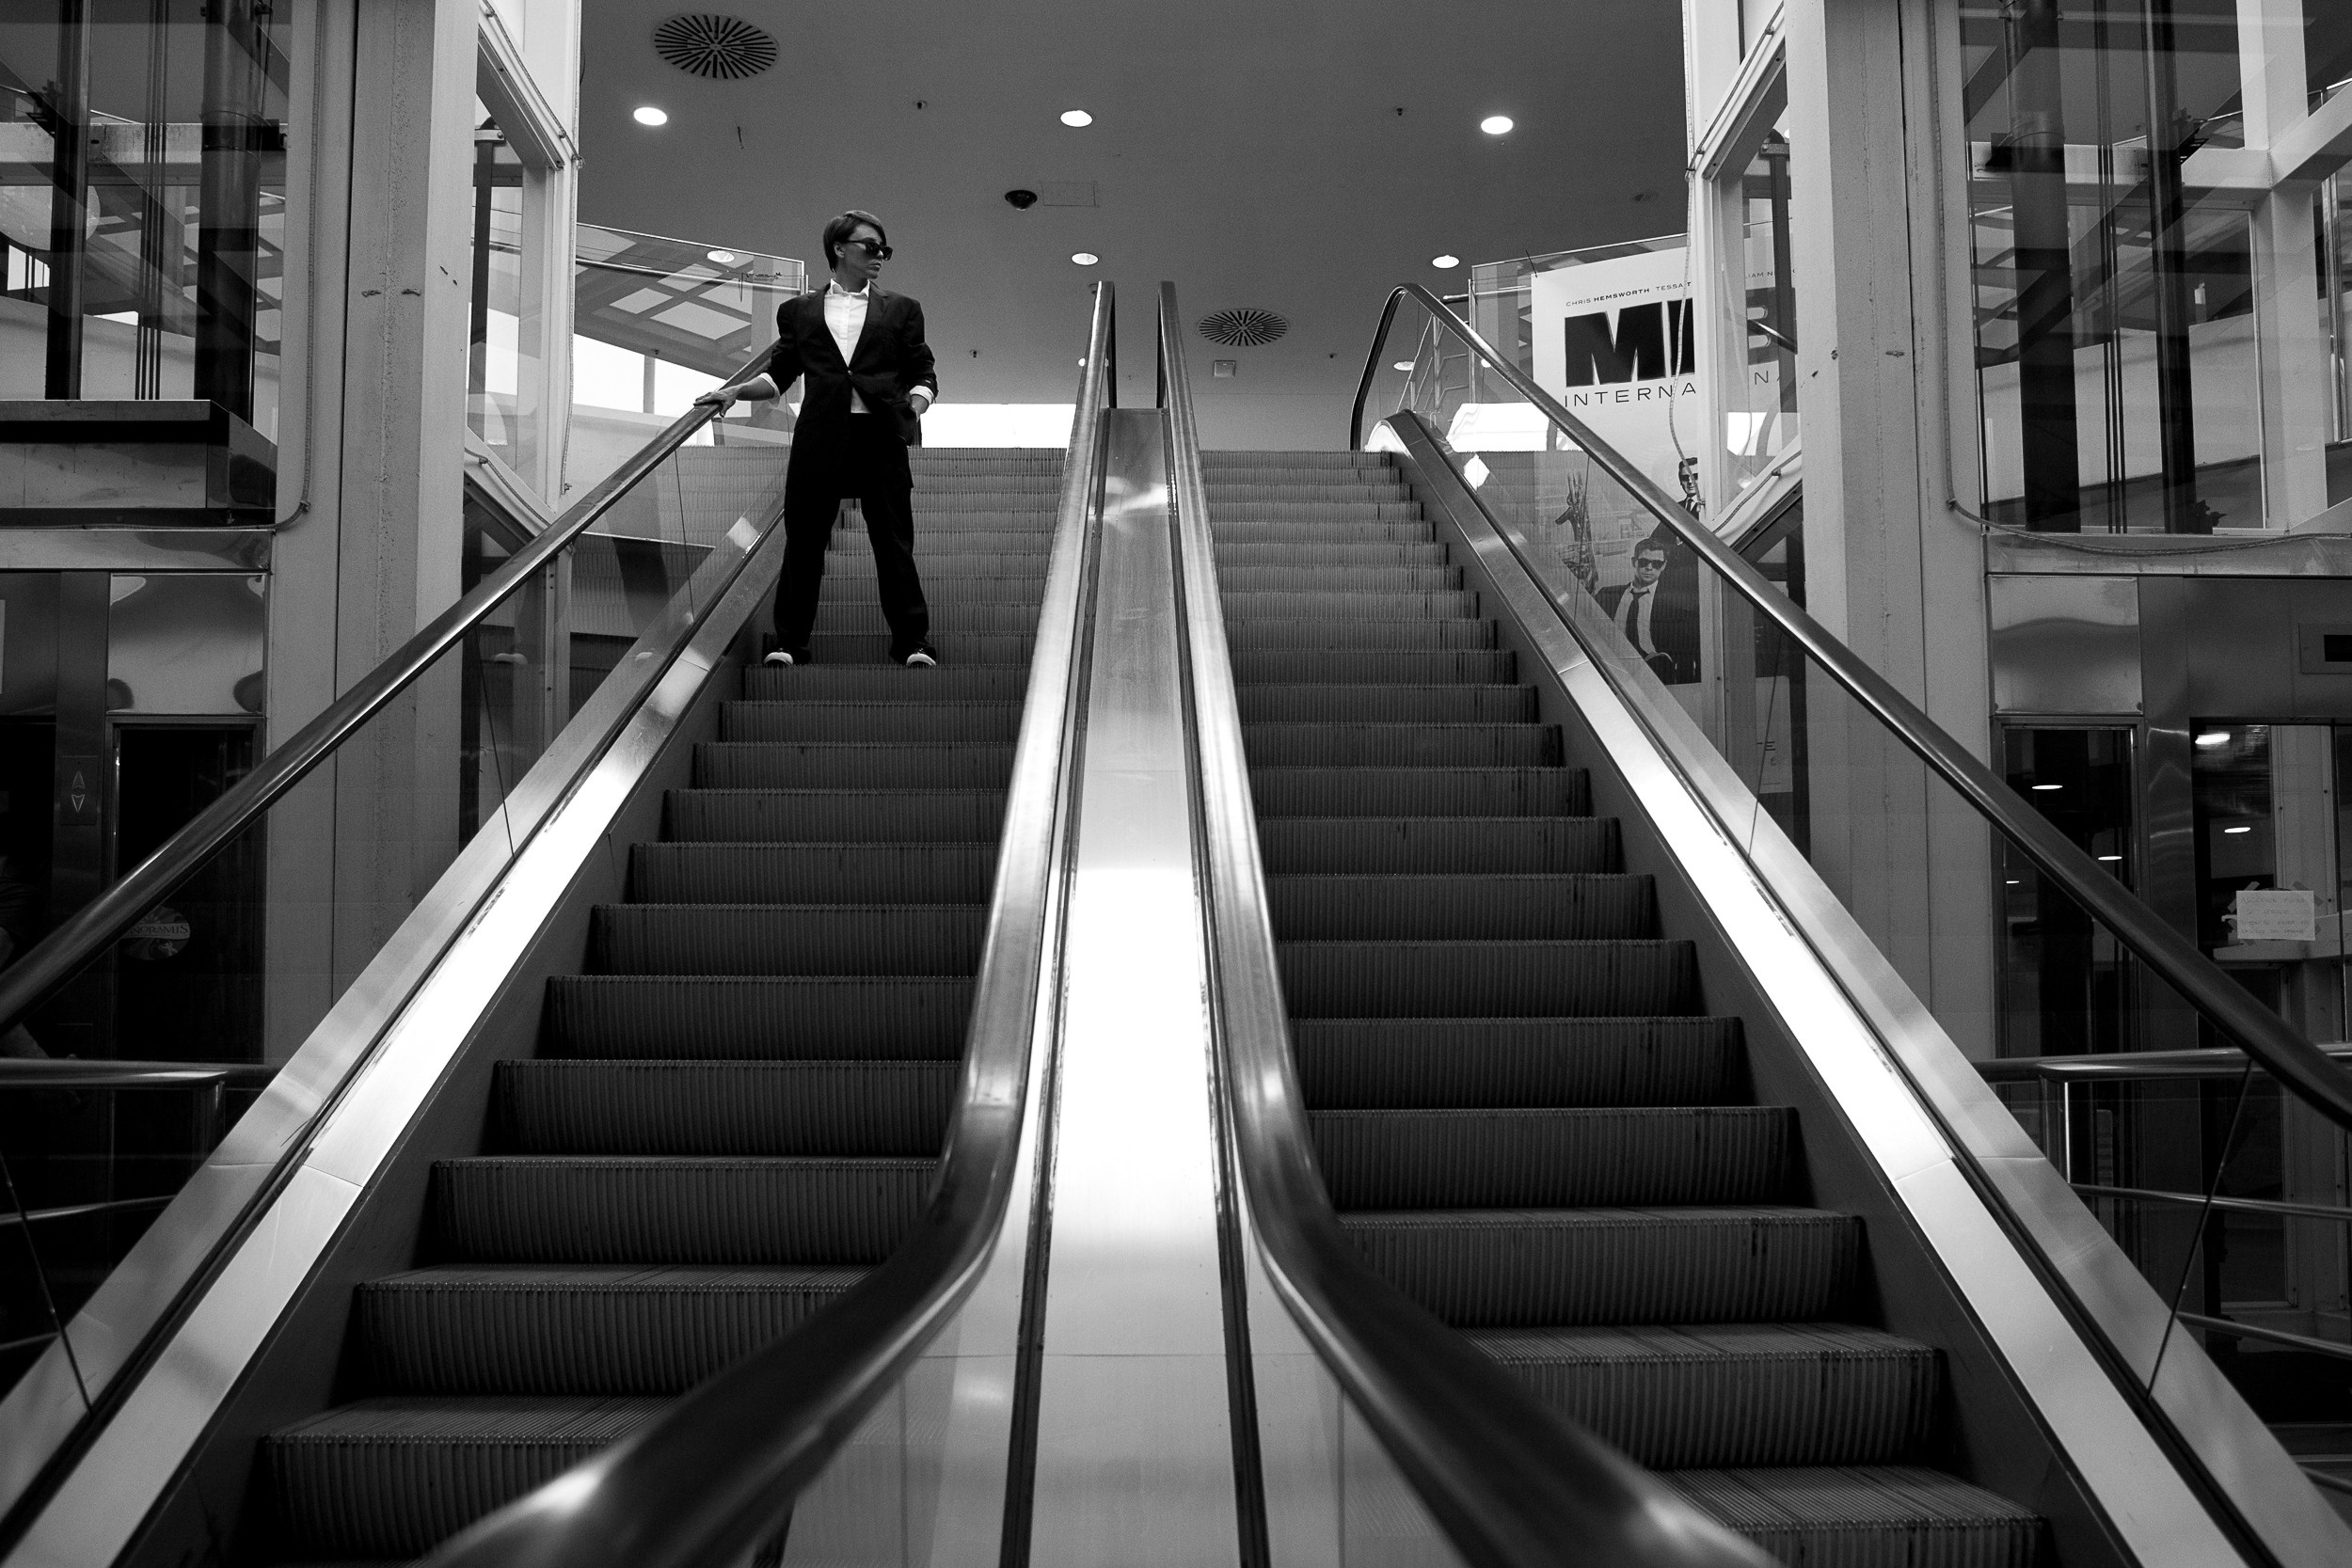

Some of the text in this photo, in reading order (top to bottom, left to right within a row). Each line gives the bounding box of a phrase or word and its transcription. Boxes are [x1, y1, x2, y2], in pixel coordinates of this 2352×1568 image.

[1565, 298, 1592, 308] CHRIS
[1593, 288, 1650, 302] HEMSWORTH
[1656, 281, 1684, 292] TESSA
[130, 924, 189, 934] NORAMIS
